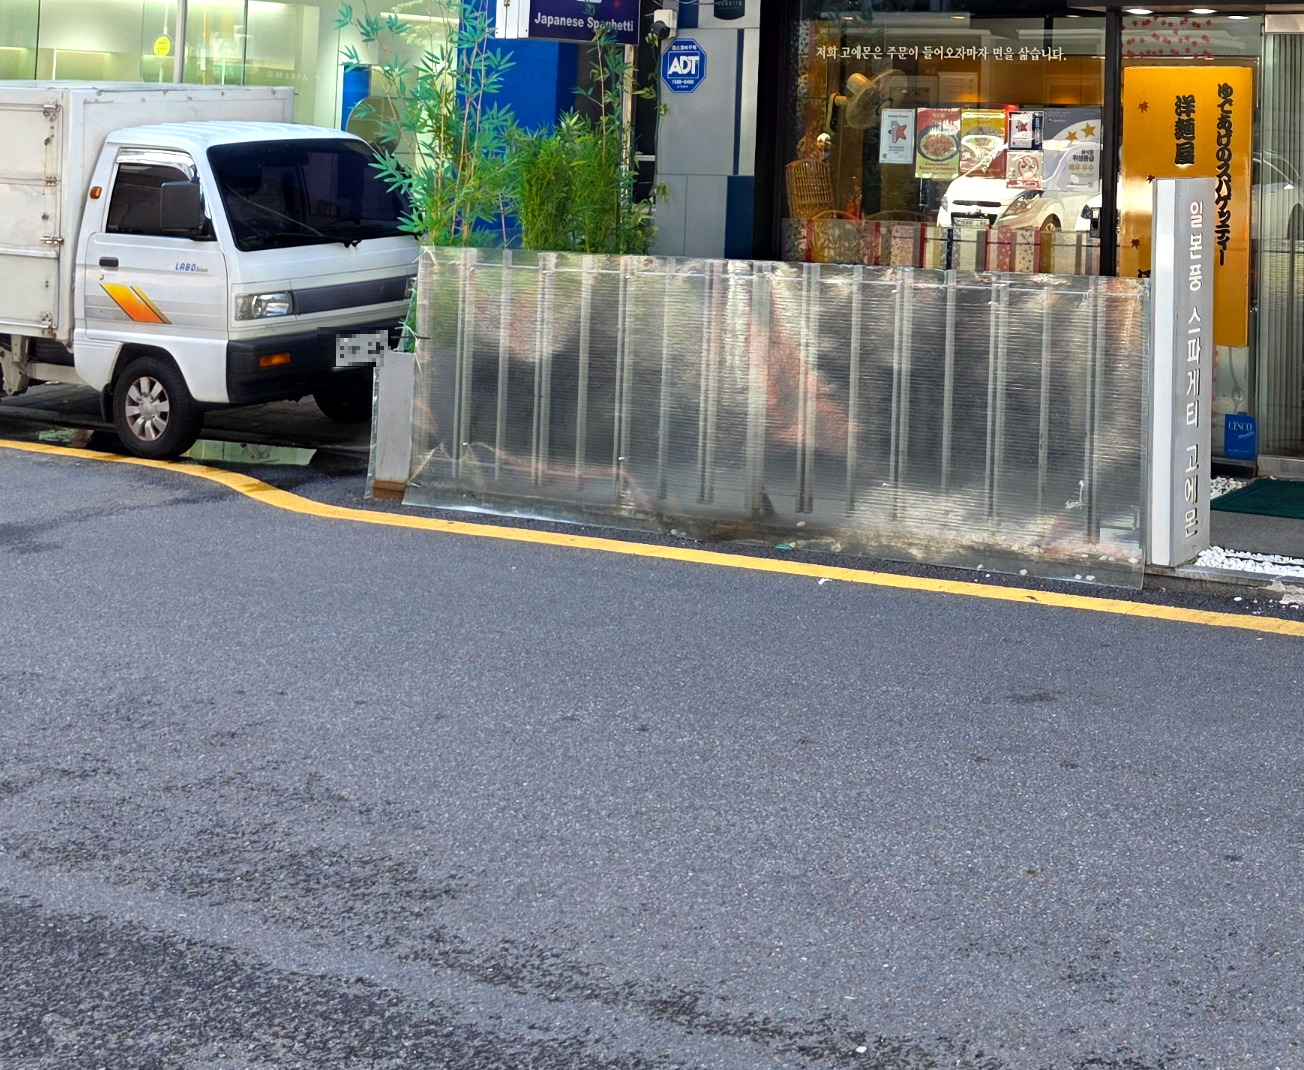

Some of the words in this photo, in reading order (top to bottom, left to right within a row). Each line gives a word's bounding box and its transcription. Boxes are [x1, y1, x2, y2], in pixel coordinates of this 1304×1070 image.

[534, 12, 584, 27] Japanese
[816, 45, 837, 60] 저희
[840, 44, 883, 60] 고에몬은
[887, 45, 919, 60] 주문이
[922, 45, 989, 61] 들어오자마자
[993, 46, 1015, 61] 면을
[1018, 46, 1067, 61] 삶습니다.
[667, 55, 699, 74] ADT
[1188, 200, 1203, 292] 일본풍
[175, 262, 196, 271] LABO
[1186, 306, 1202, 428] 스파게티
[1184, 444, 1200, 538] 고에몬
